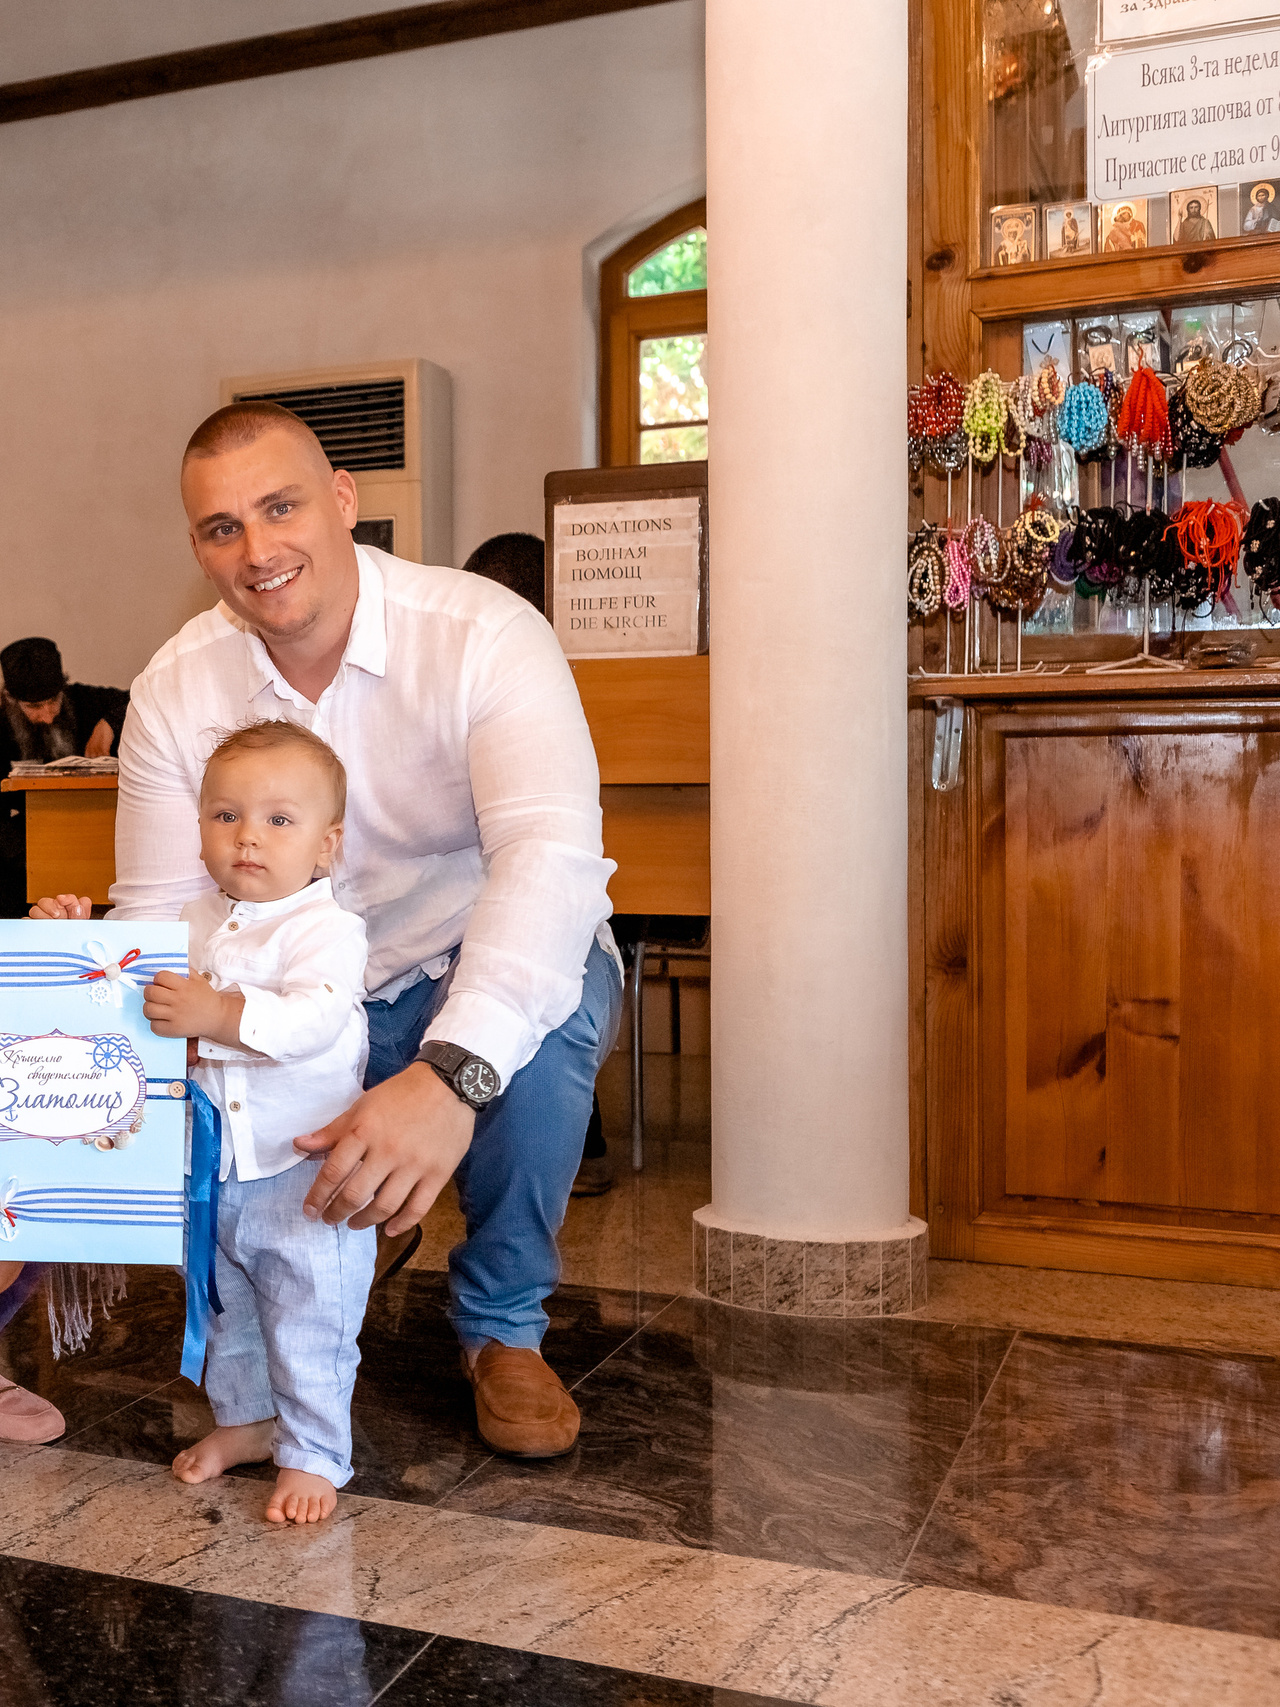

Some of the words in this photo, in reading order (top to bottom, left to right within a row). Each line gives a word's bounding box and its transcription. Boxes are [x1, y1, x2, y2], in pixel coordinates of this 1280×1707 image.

[1120, 2, 1138, 13] за
[1141, 63, 1185, 88] Всяка
[1190, 55, 1219, 81] 3-та
[1224, 50, 1280, 77] неделя
[1097, 109, 1187, 143] Литургията
[1191, 100, 1252, 126] започва
[1256, 97, 1274, 116] от
[1105, 154, 1187, 191] Причастие
[1191, 152, 1206, 172] се
[1210, 147, 1245, 175] дава
[1249, 144, 1267, 164] от
[571, 518, 672, 536] DONATIONS
[576, 546, 648, 562] ВОЛНАЯ
[572, 566, 642, 581] ПОМОЩ
[570, 597, 619, 611] HILFE
[570, 617, 598, 630] DIE
[603, 614, 668, 630] KIRCHE
